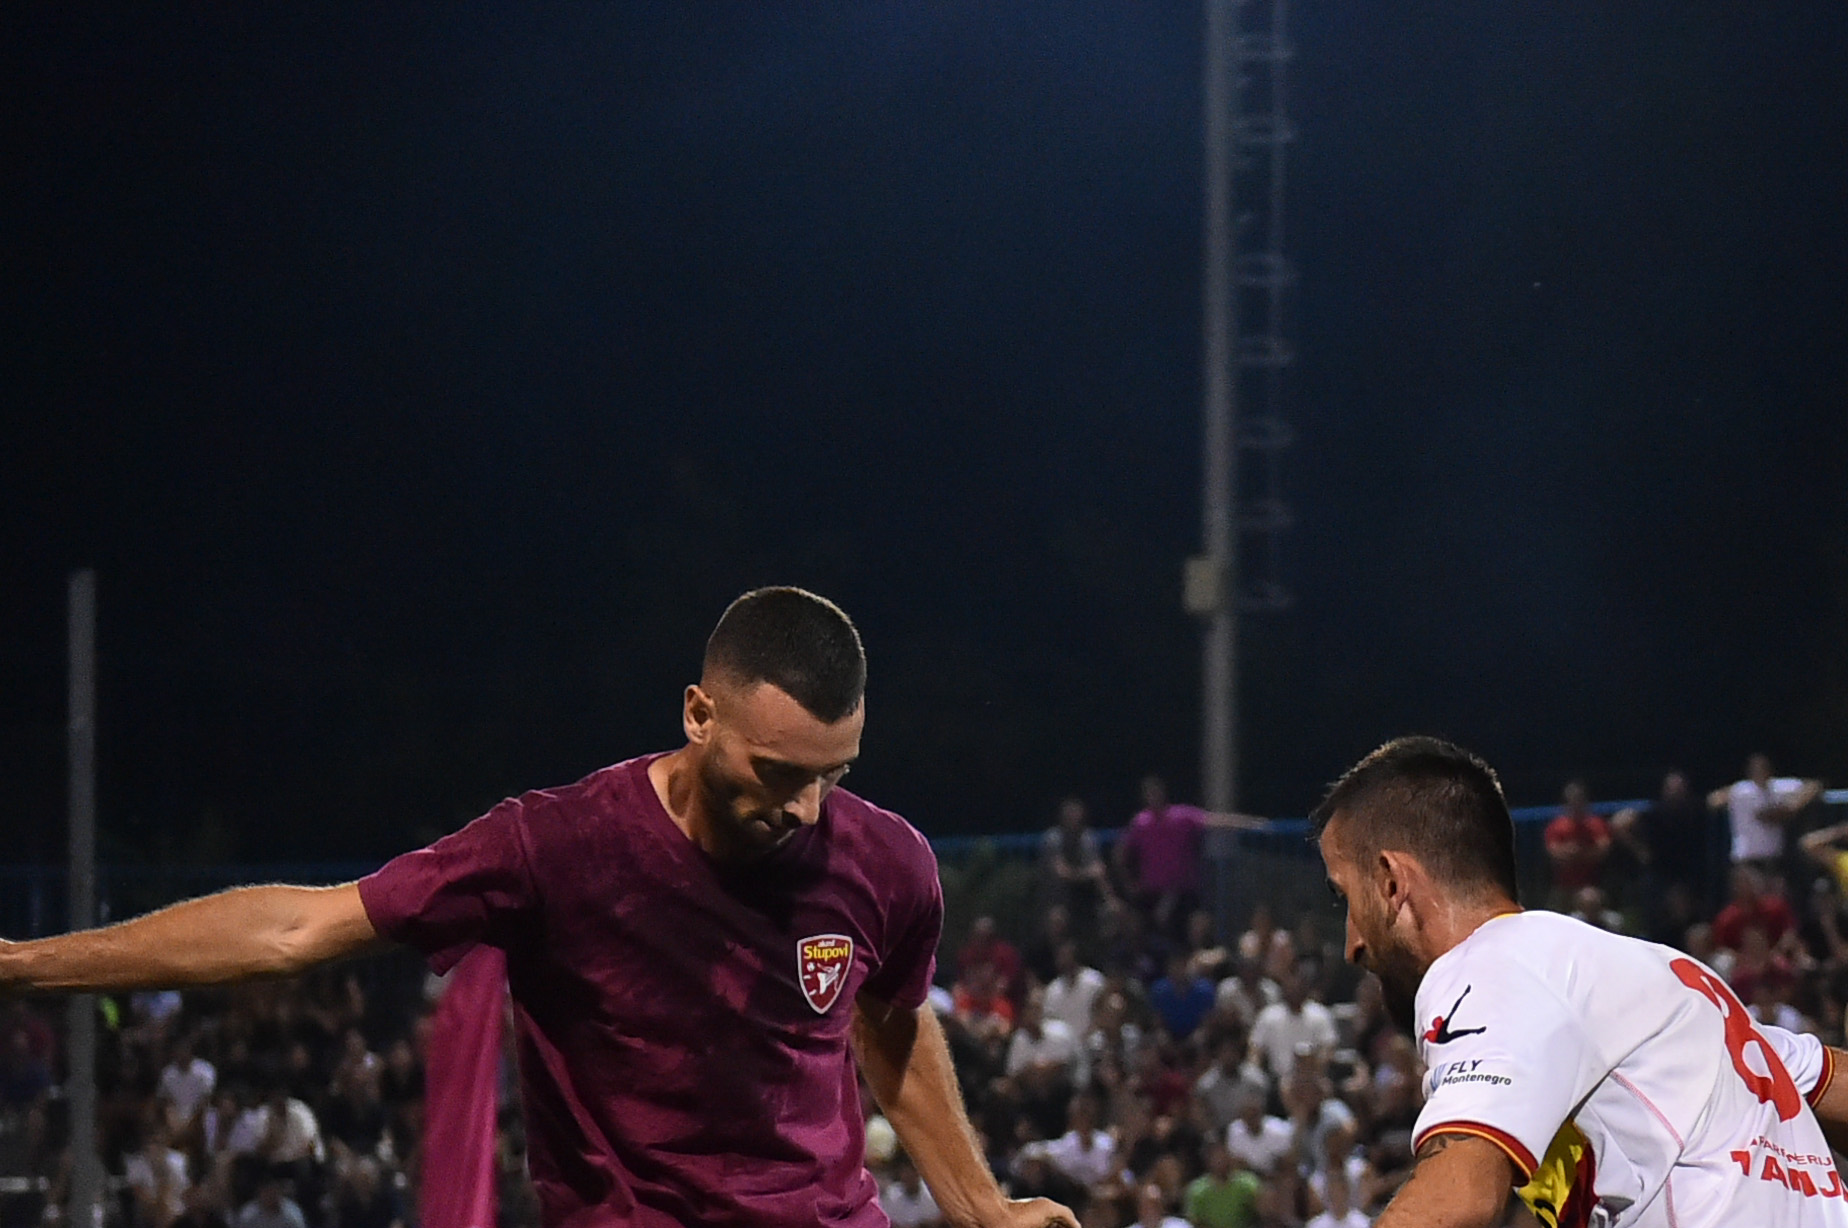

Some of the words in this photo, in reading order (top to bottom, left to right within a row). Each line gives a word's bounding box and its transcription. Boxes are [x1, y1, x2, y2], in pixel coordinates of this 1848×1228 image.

[1669, 957, 1802, 1124] 8
[1447, 1059, 1483, 1076] FLY
[1441, 1073, 1512, 1087] Montenegro
